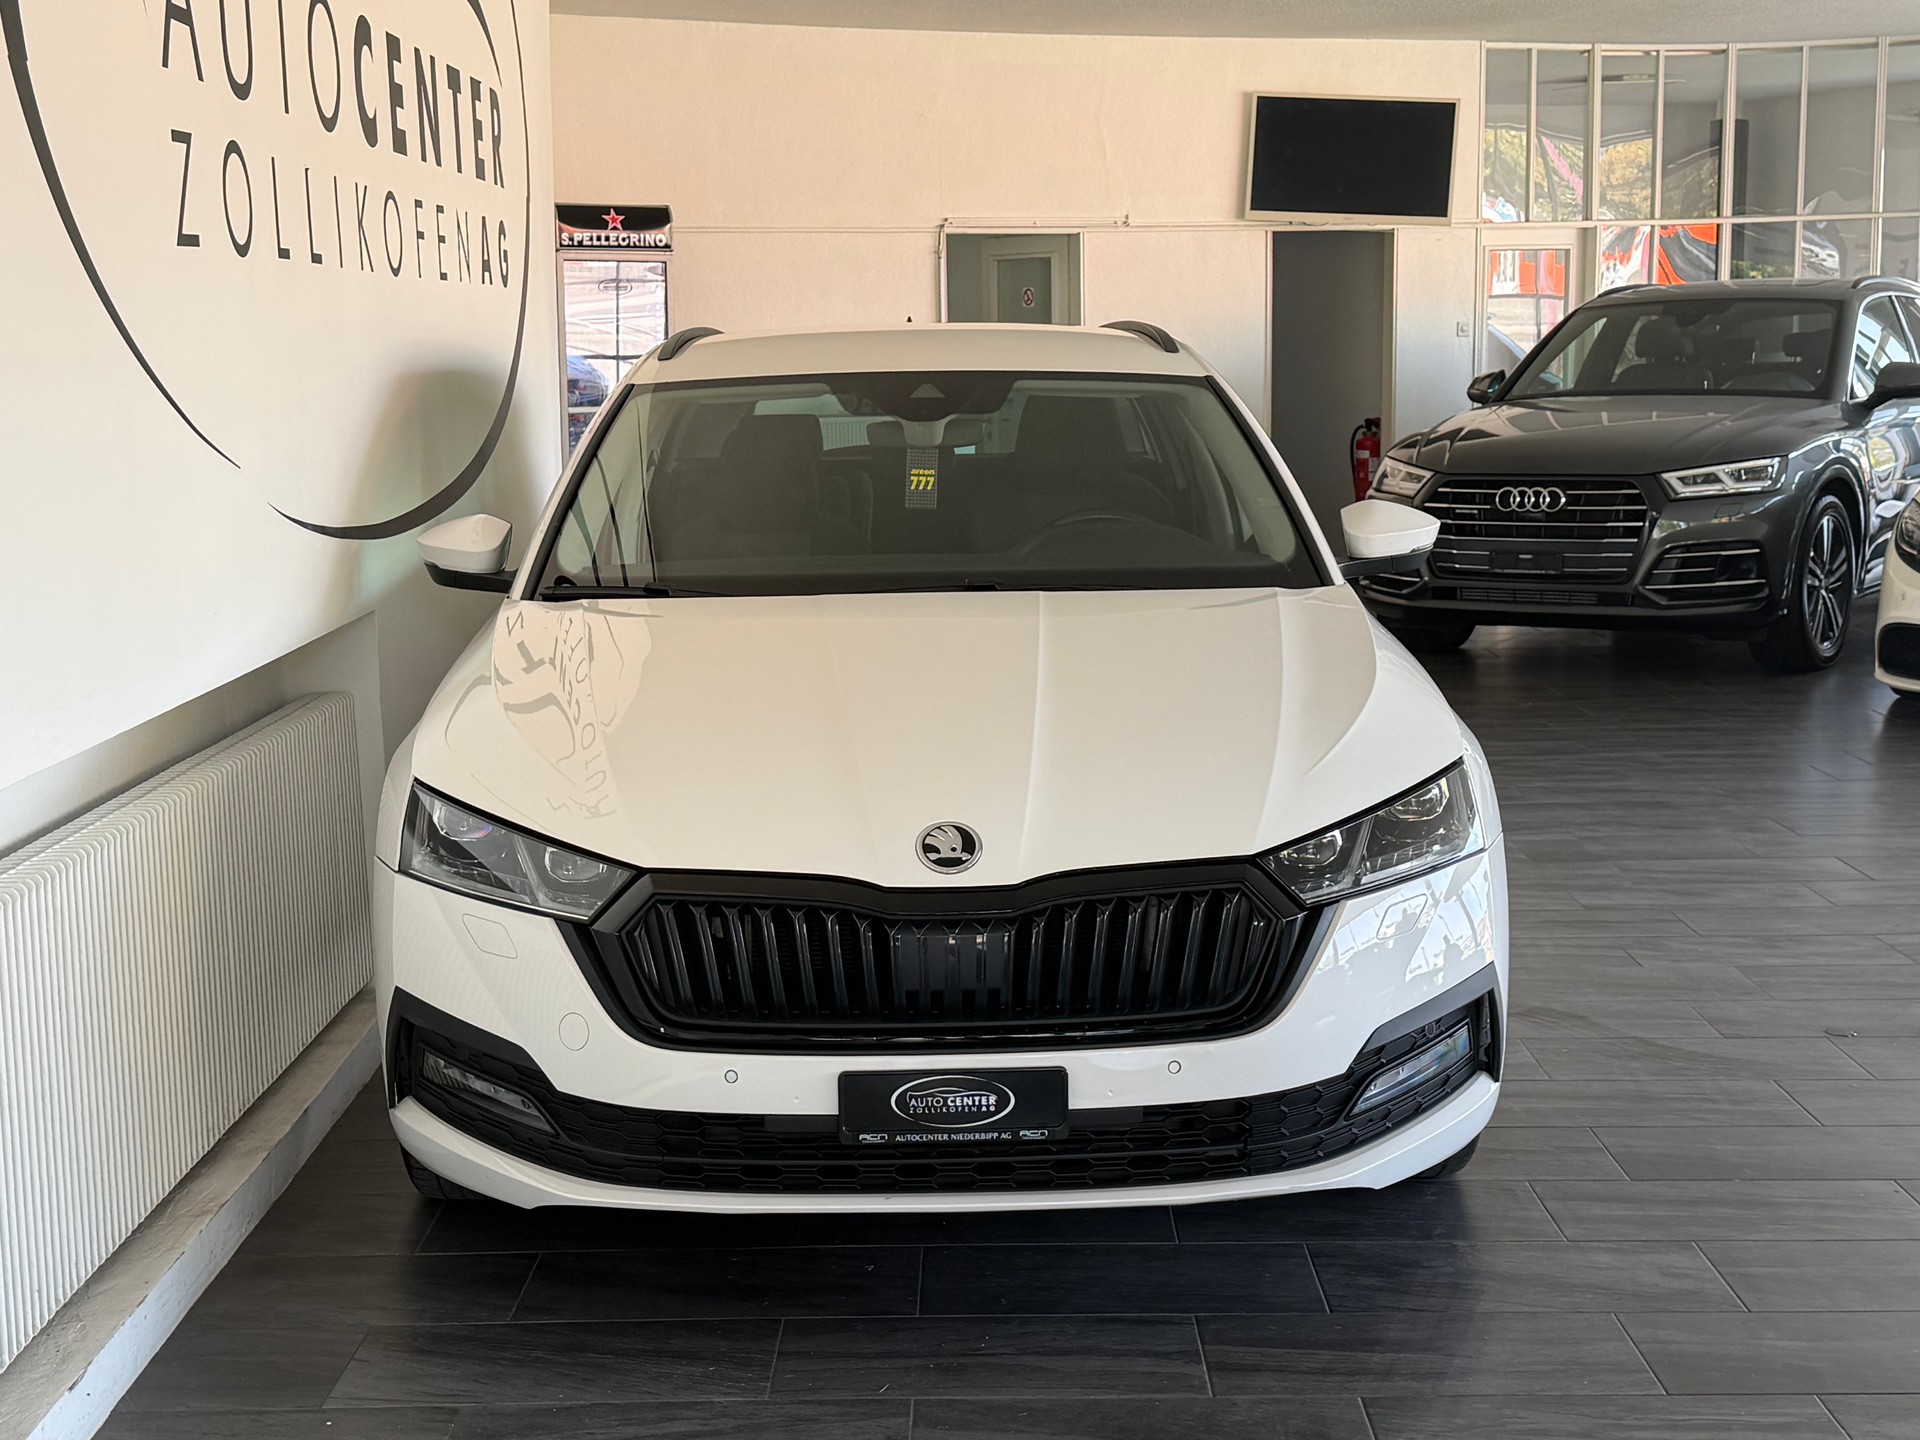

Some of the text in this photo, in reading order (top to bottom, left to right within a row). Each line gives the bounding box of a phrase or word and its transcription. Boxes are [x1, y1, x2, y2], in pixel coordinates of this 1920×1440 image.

[910, 476, 935, 490] 777
[909, 1096, 996, 1107] AUTO CENTER
[909, 1106, 977, 1114] ZOLLIKOFEN
[895, 1133, 949, 1141] AUTOCENTER
[950, 1132, 998, 1140] NIEDERBIPP
